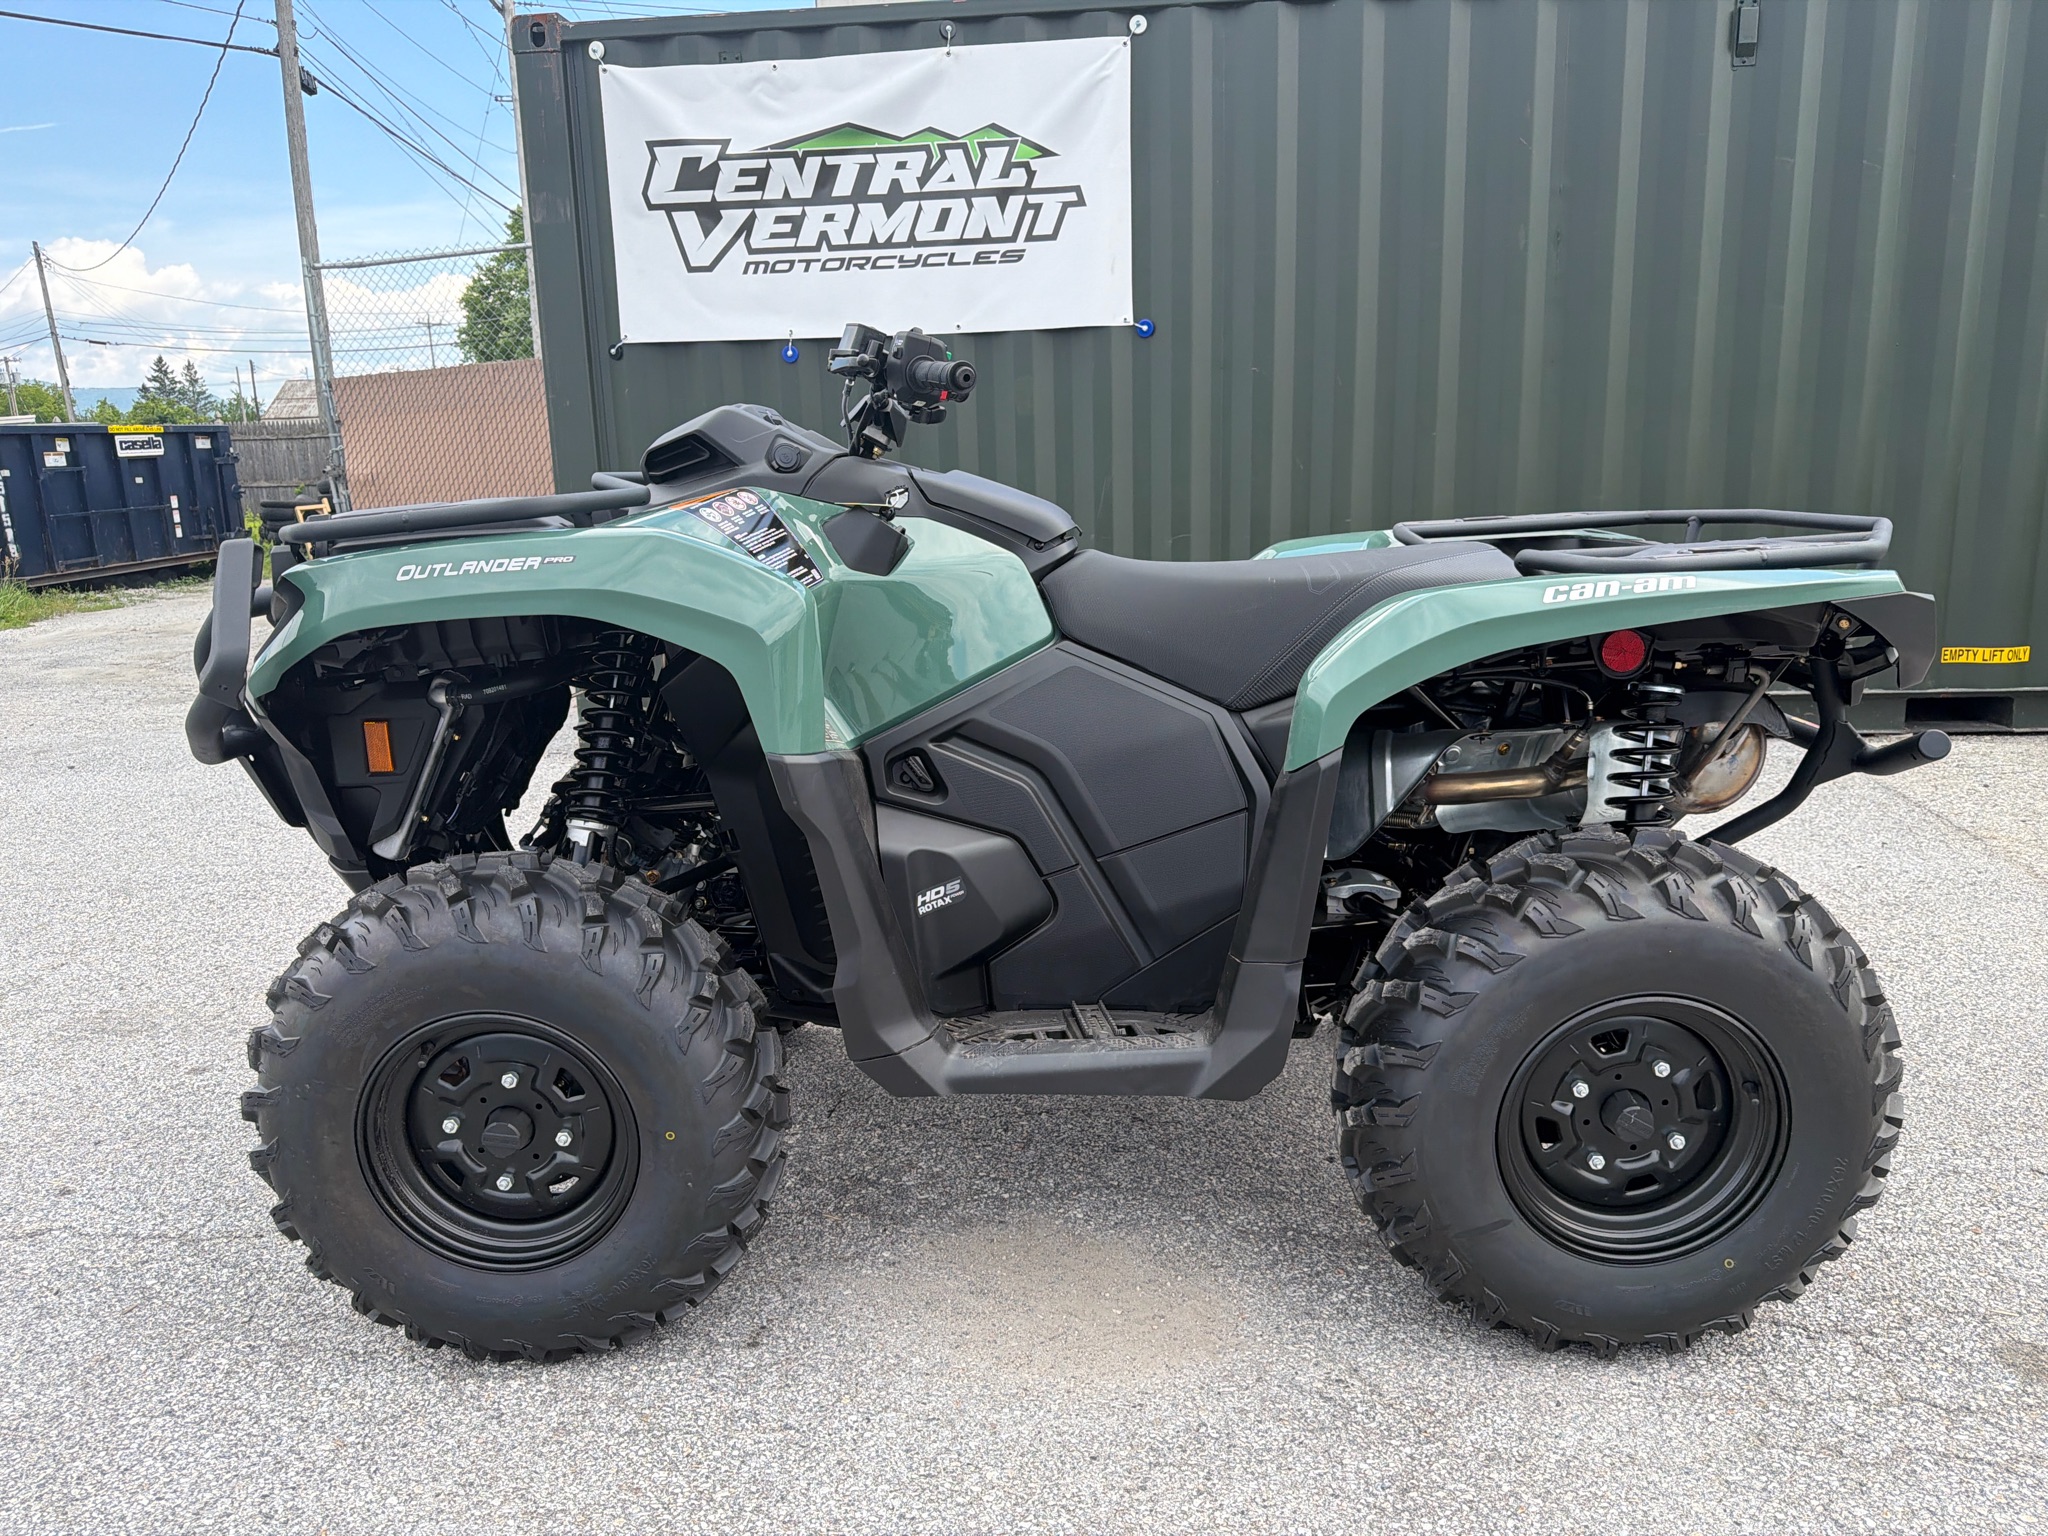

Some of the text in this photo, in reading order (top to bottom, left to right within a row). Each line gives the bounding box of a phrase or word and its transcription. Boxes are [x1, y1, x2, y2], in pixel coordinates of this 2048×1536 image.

[646, 137, 1030, 206] CENTRAL
[668, 190, 1082, 273] VERMONT
[742, 248, 1027, 275] MOTORCYCLES
[119, 437, 162, 451] casella
[396, 555, 574, 581] OUTLANDER PRO
[1542, 575, 1697, 604] can-am
[1942, 647, 2029, 662] EMPTY LIFT ONLY
[917, 879, 961, 907] HD5
[918, 895, 953, 915] ROTAX
